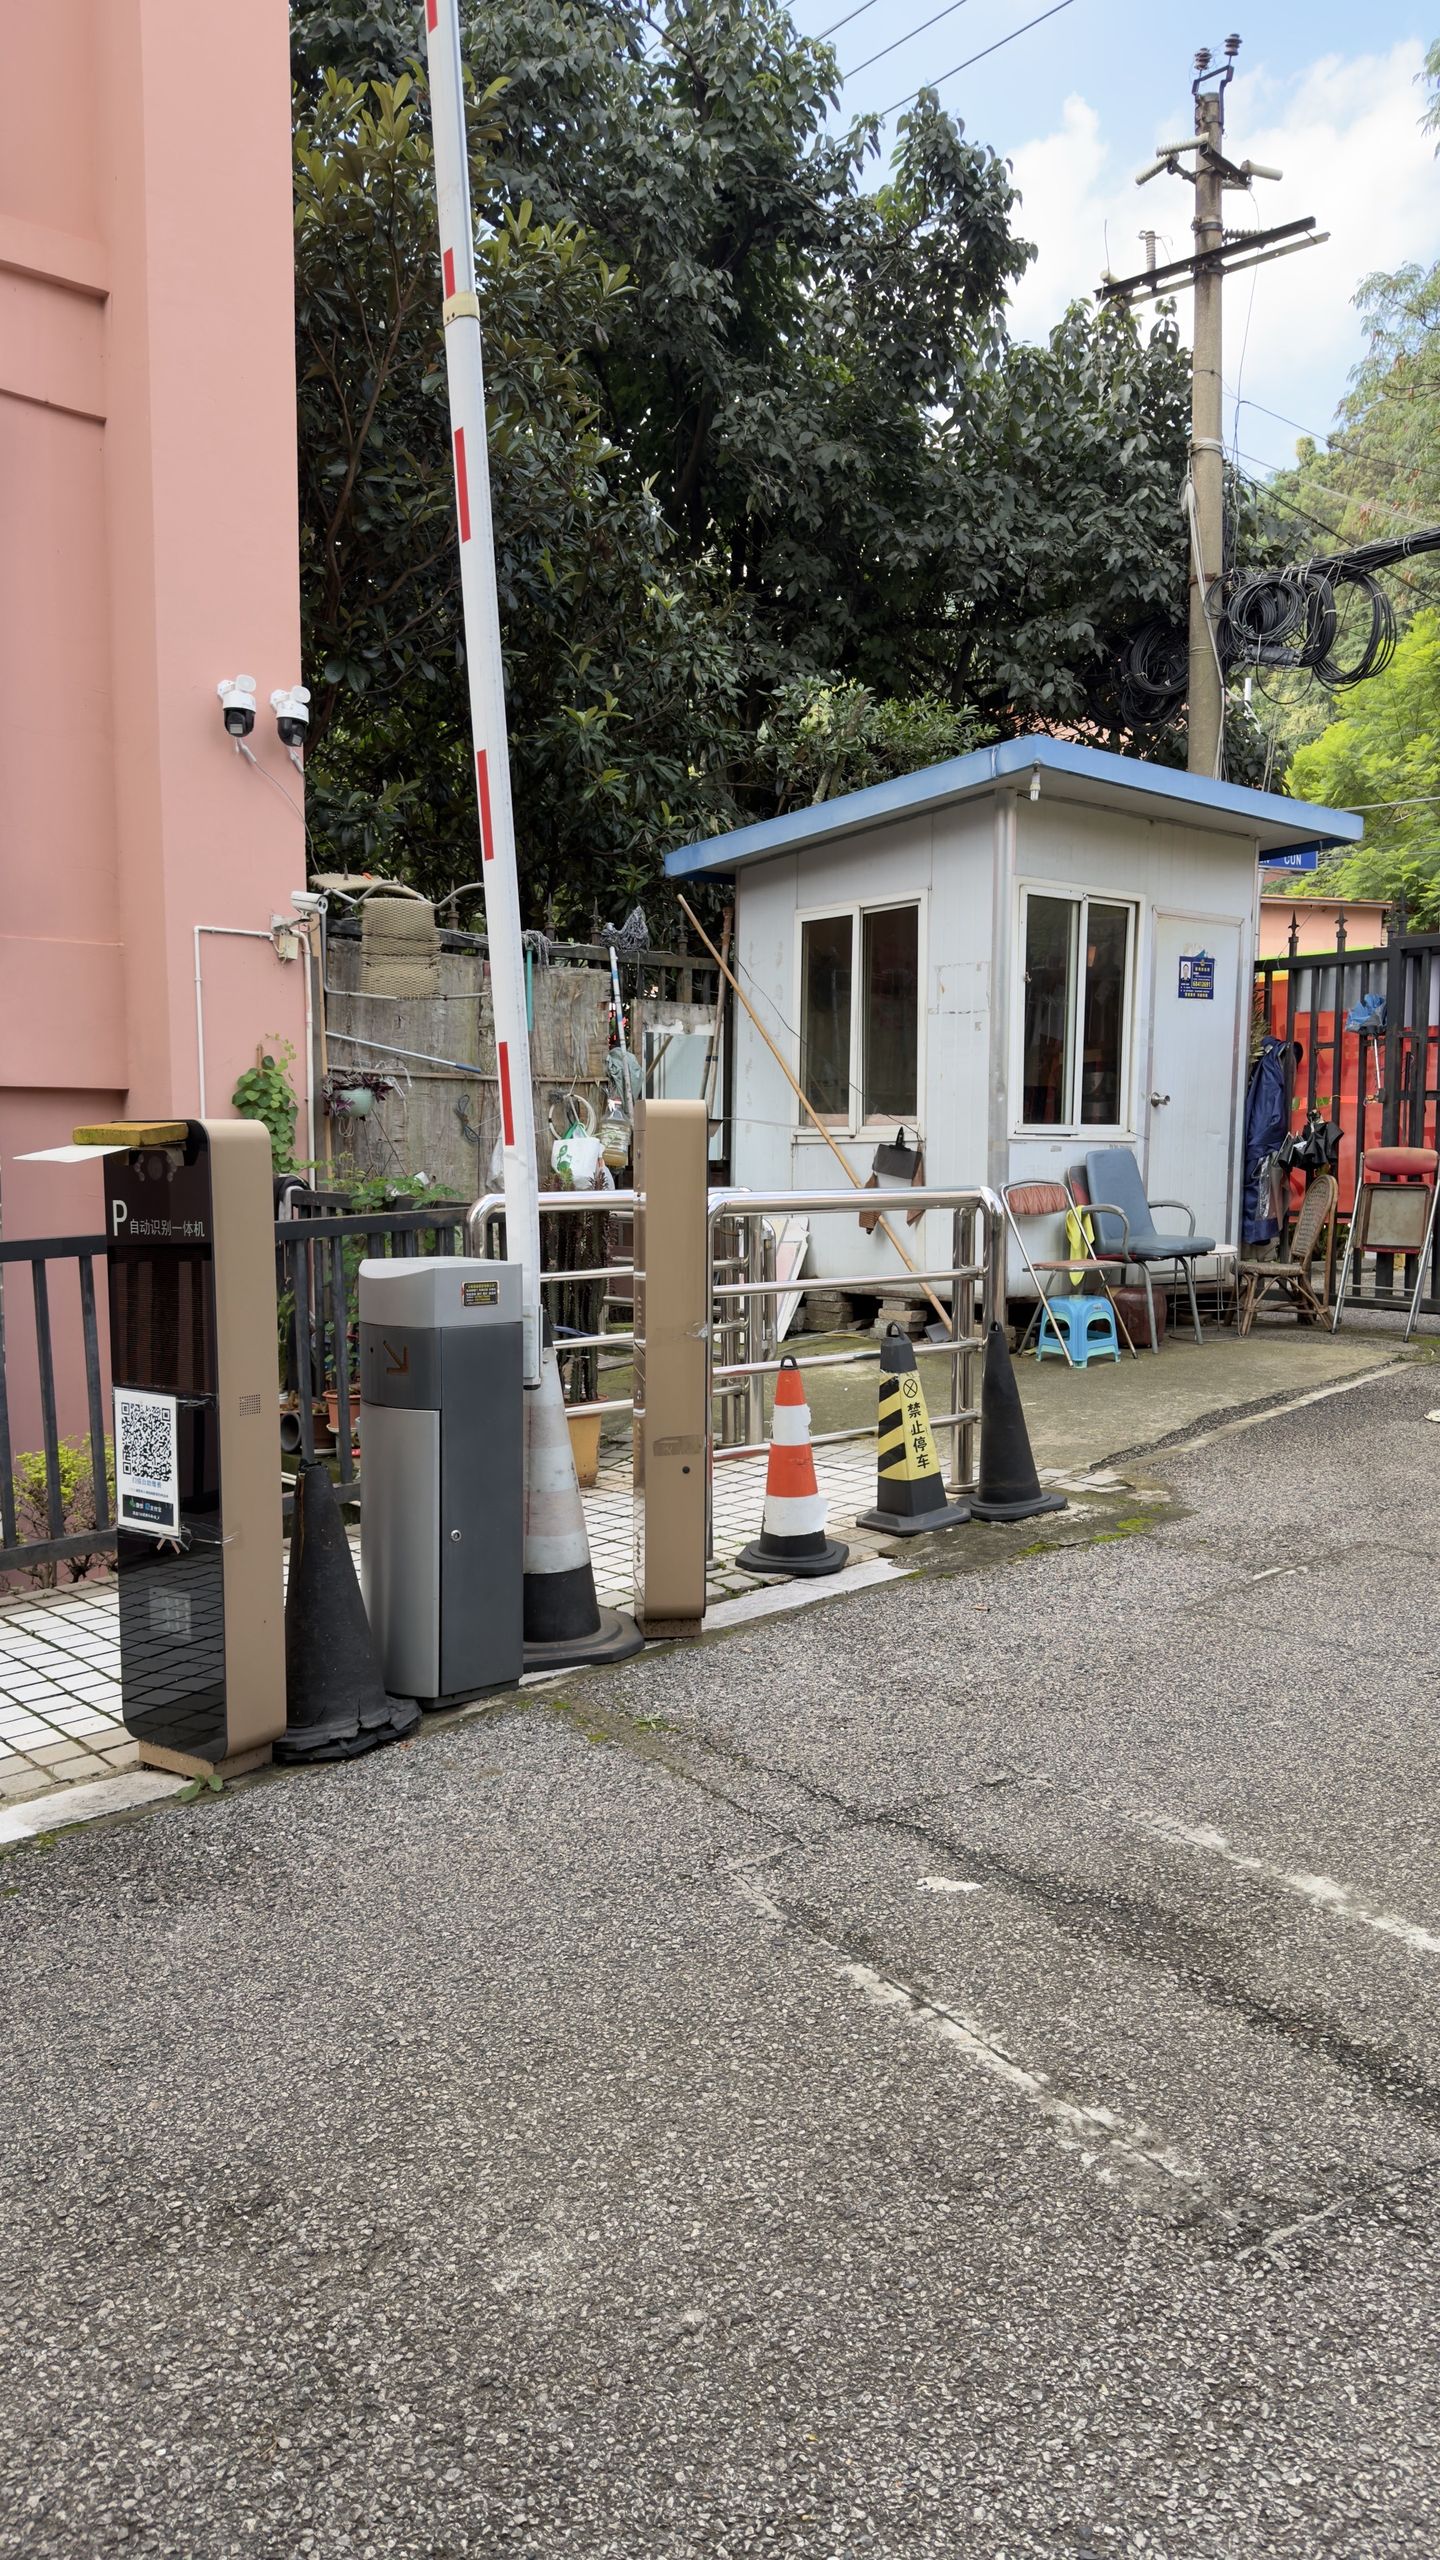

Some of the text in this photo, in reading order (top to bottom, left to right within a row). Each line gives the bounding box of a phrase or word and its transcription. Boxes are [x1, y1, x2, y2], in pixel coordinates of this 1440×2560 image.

[112, 1199, 205, 1237] P 自动识别一体机
[907, 1402, 930, 1469] 禁止停车
